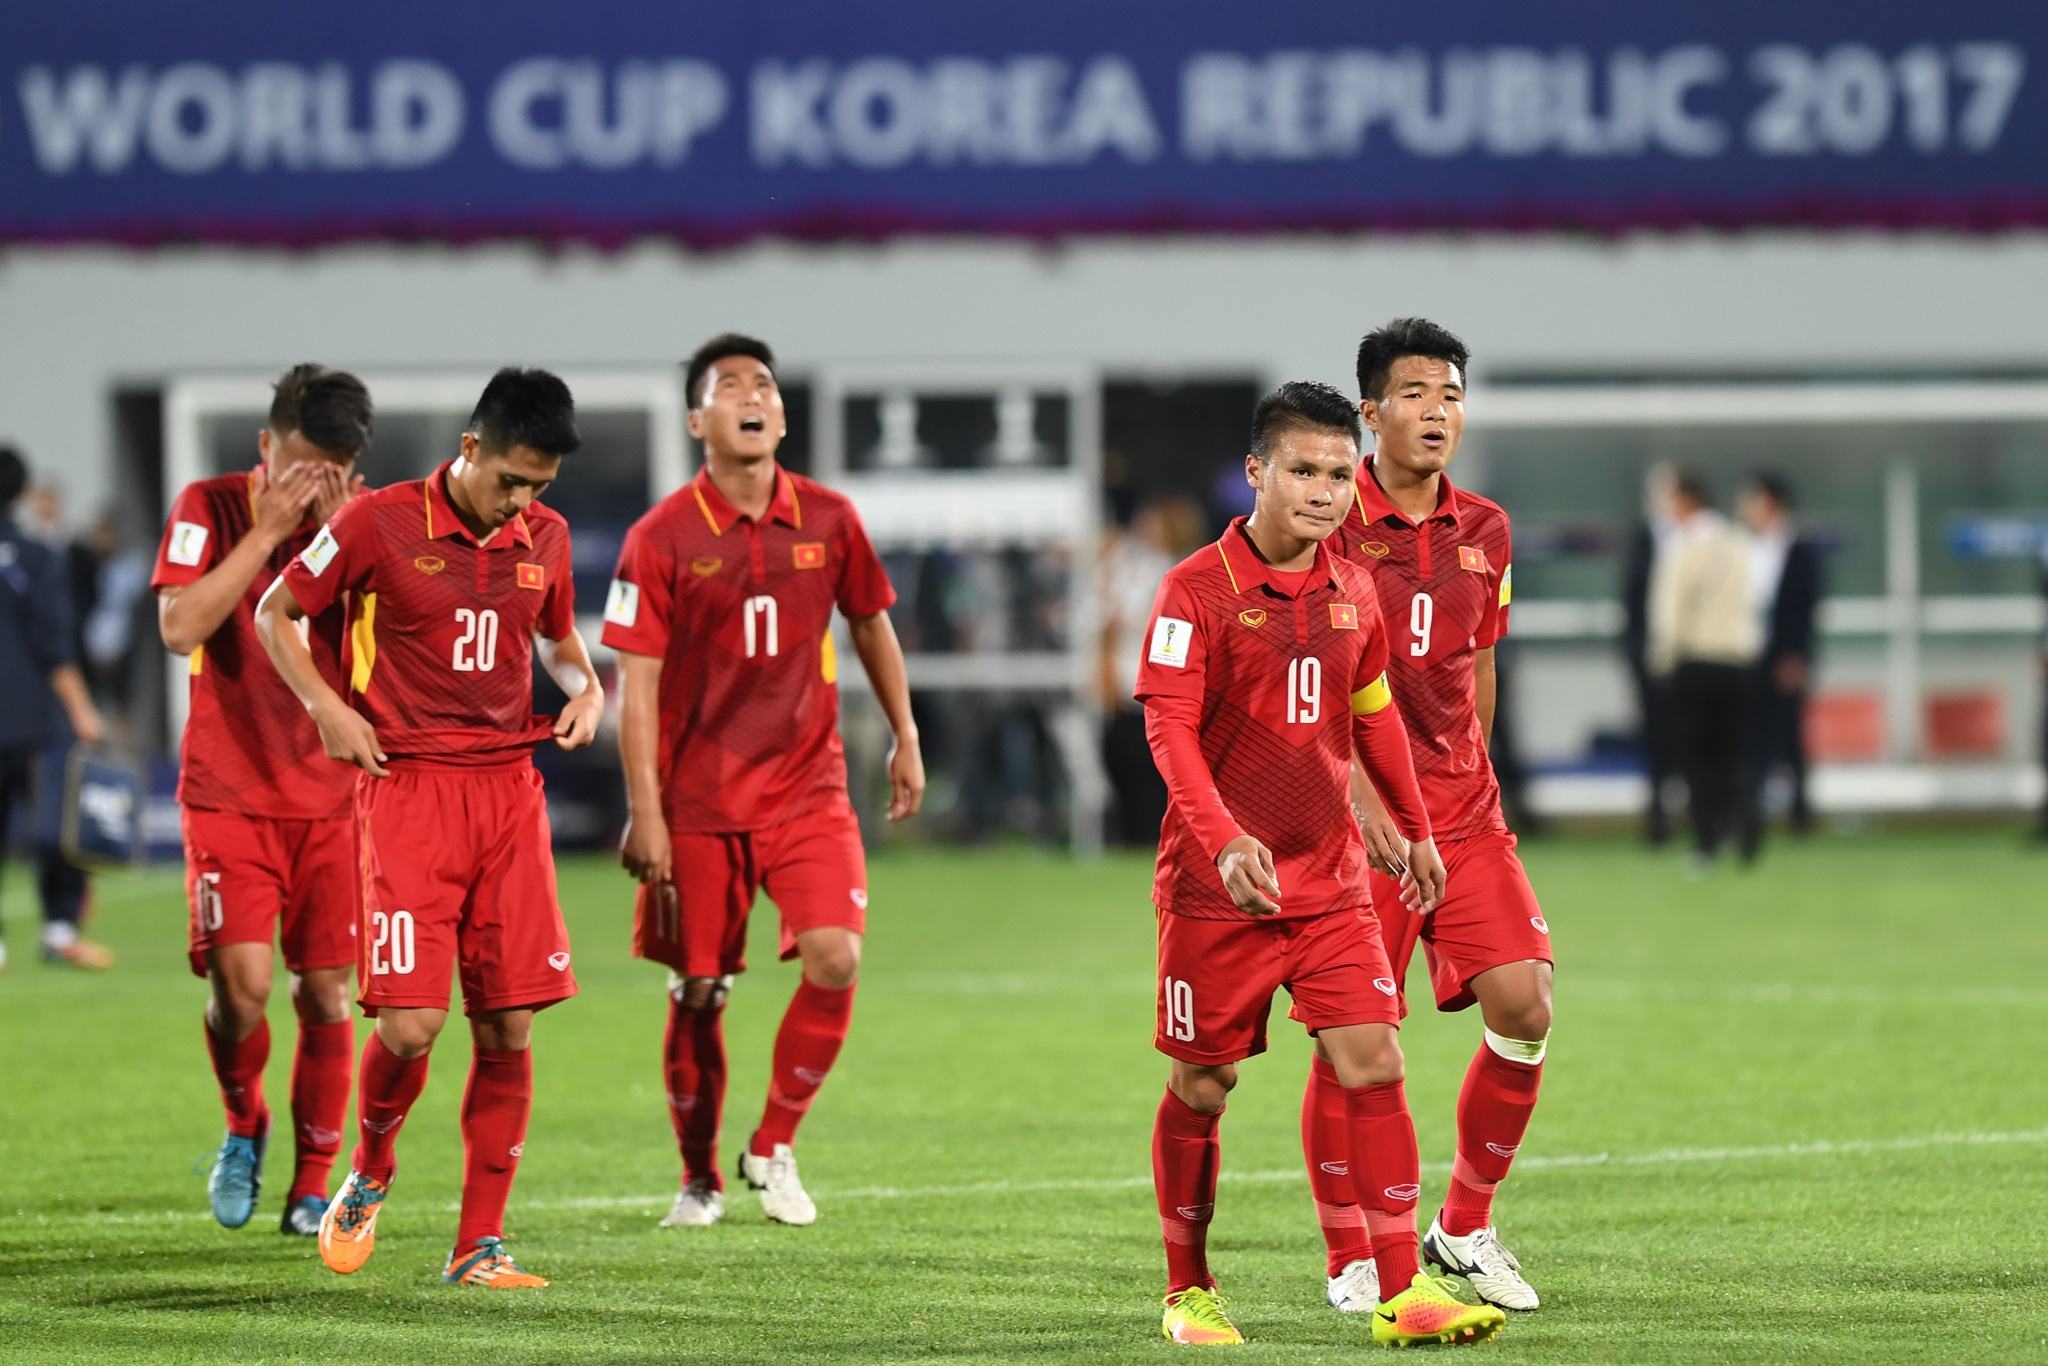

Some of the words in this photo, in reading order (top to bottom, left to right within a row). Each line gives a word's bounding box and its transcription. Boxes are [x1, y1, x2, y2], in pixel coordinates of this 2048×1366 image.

[20, 61, 465, 173] WORLD
[489, 58, 728, 169] CUP
[749, 55, 1162, 168] KOREA
[1180, 48, 1727, 158] REPUBLIC
[1747, 42, 2026, 156] 2017
[452, 608, 499, 672] 20
[743, 594, 779, 659] 17
[1410, 592, 1433, 657] 9
[1287, 656, 1321, 724] 19
[372, 910, 415, 975] 20
[1165, 975, 1195, 1043] 19
